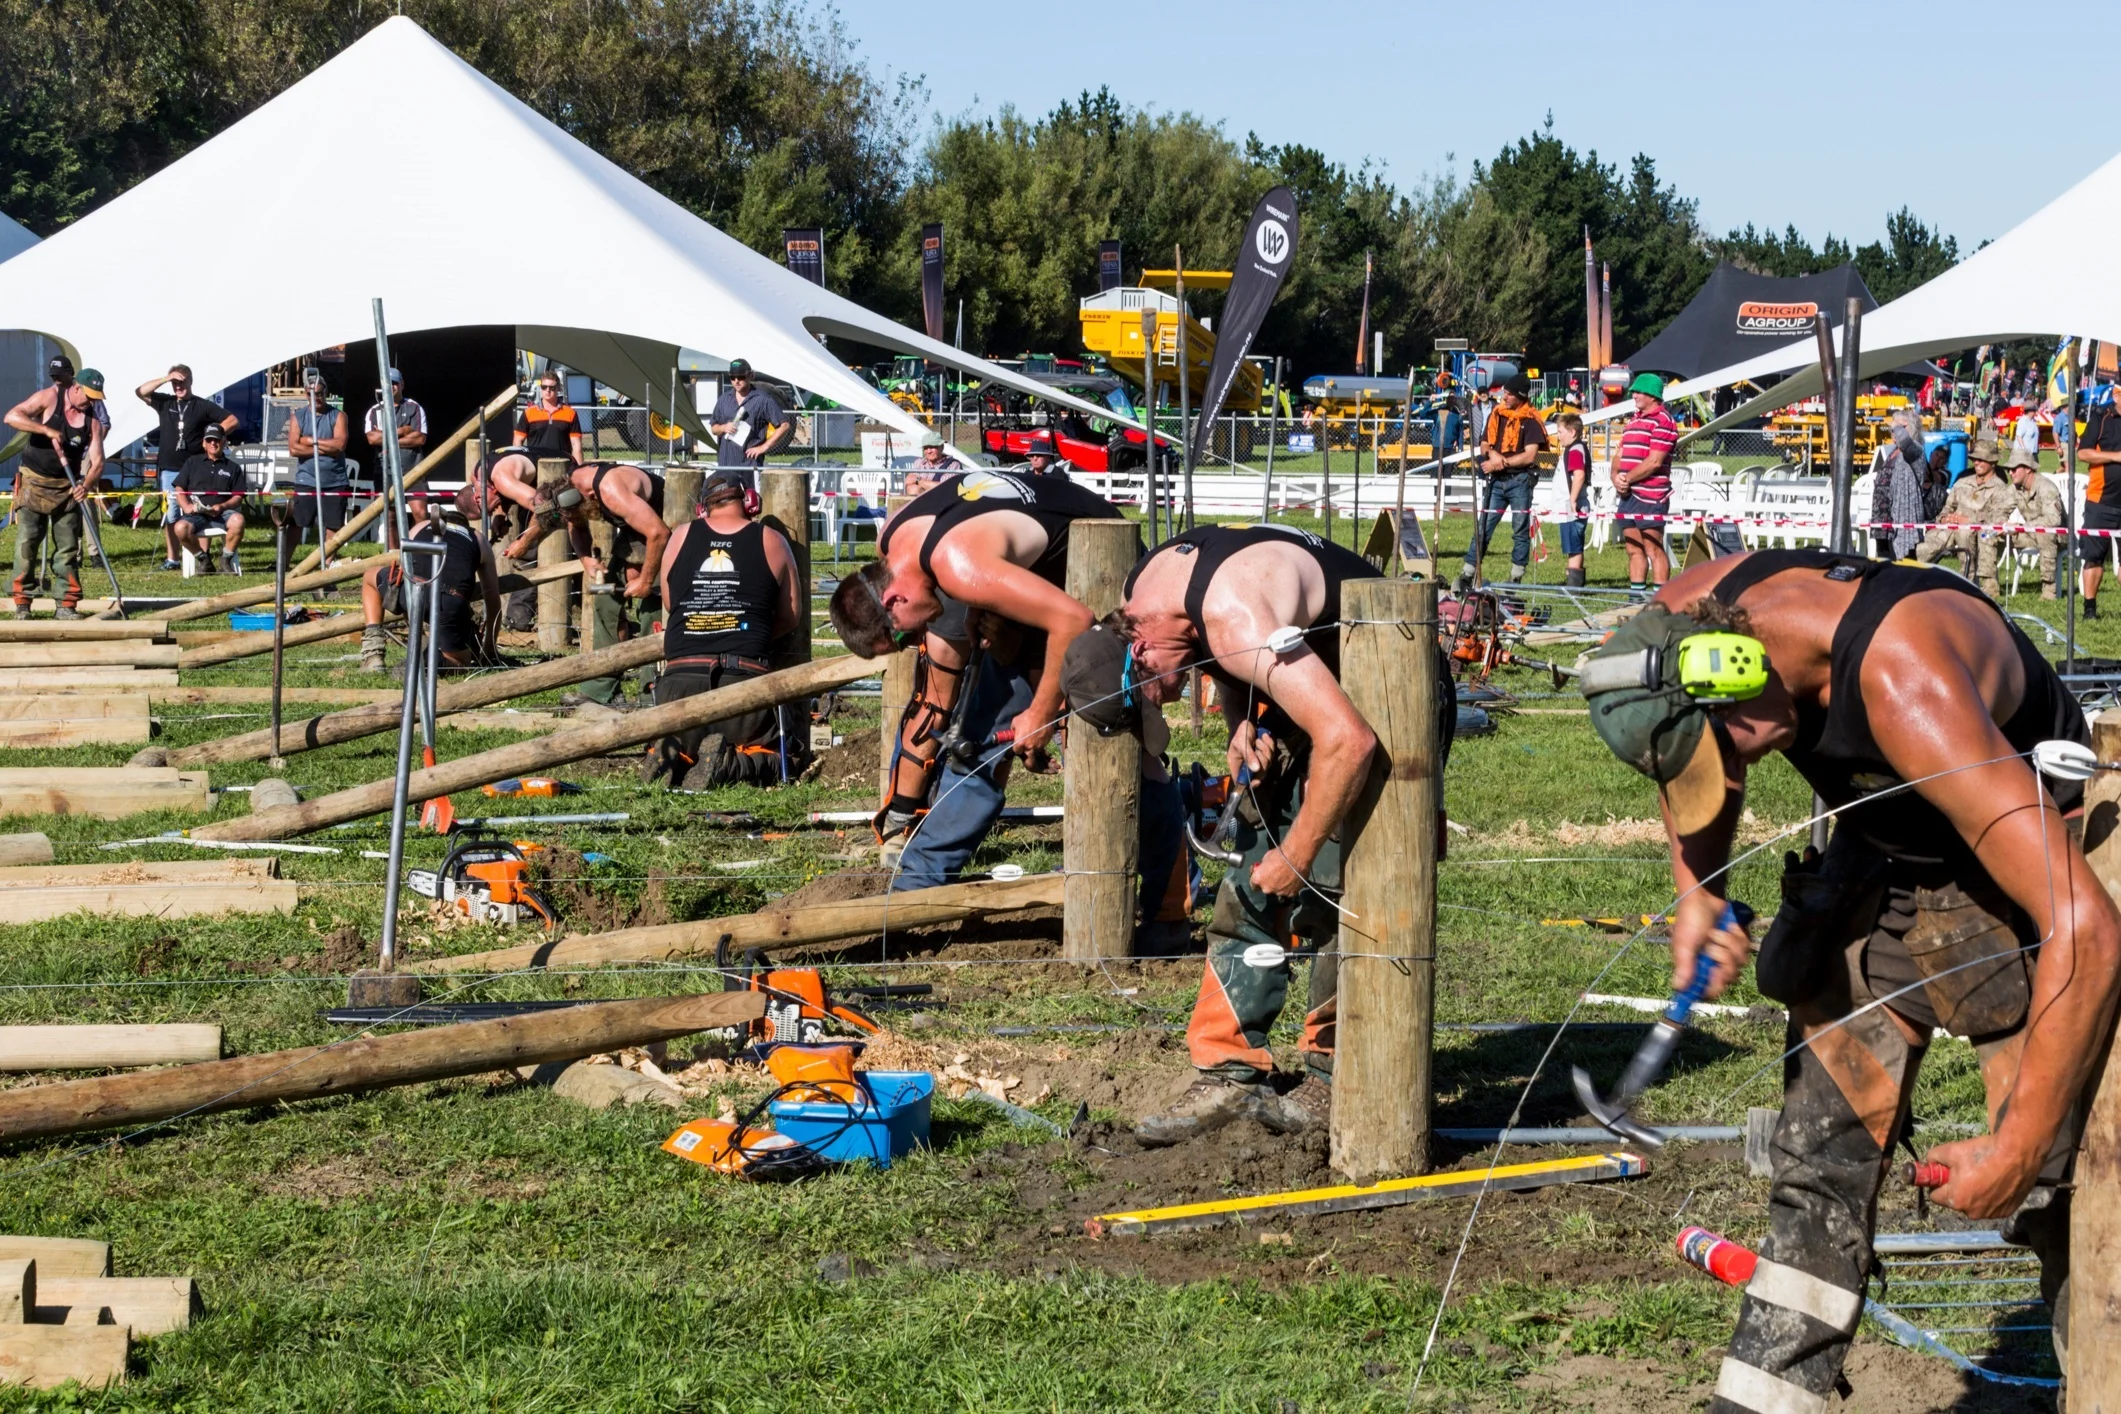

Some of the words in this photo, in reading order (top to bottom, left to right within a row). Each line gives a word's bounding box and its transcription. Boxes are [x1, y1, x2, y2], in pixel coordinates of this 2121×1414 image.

[1748, 305, 1809, 315] ORIGIN
[1745, 317, 1807, 328] AGROUP
[1206, 332, 1252, 428] www.wiremark.co.nz
